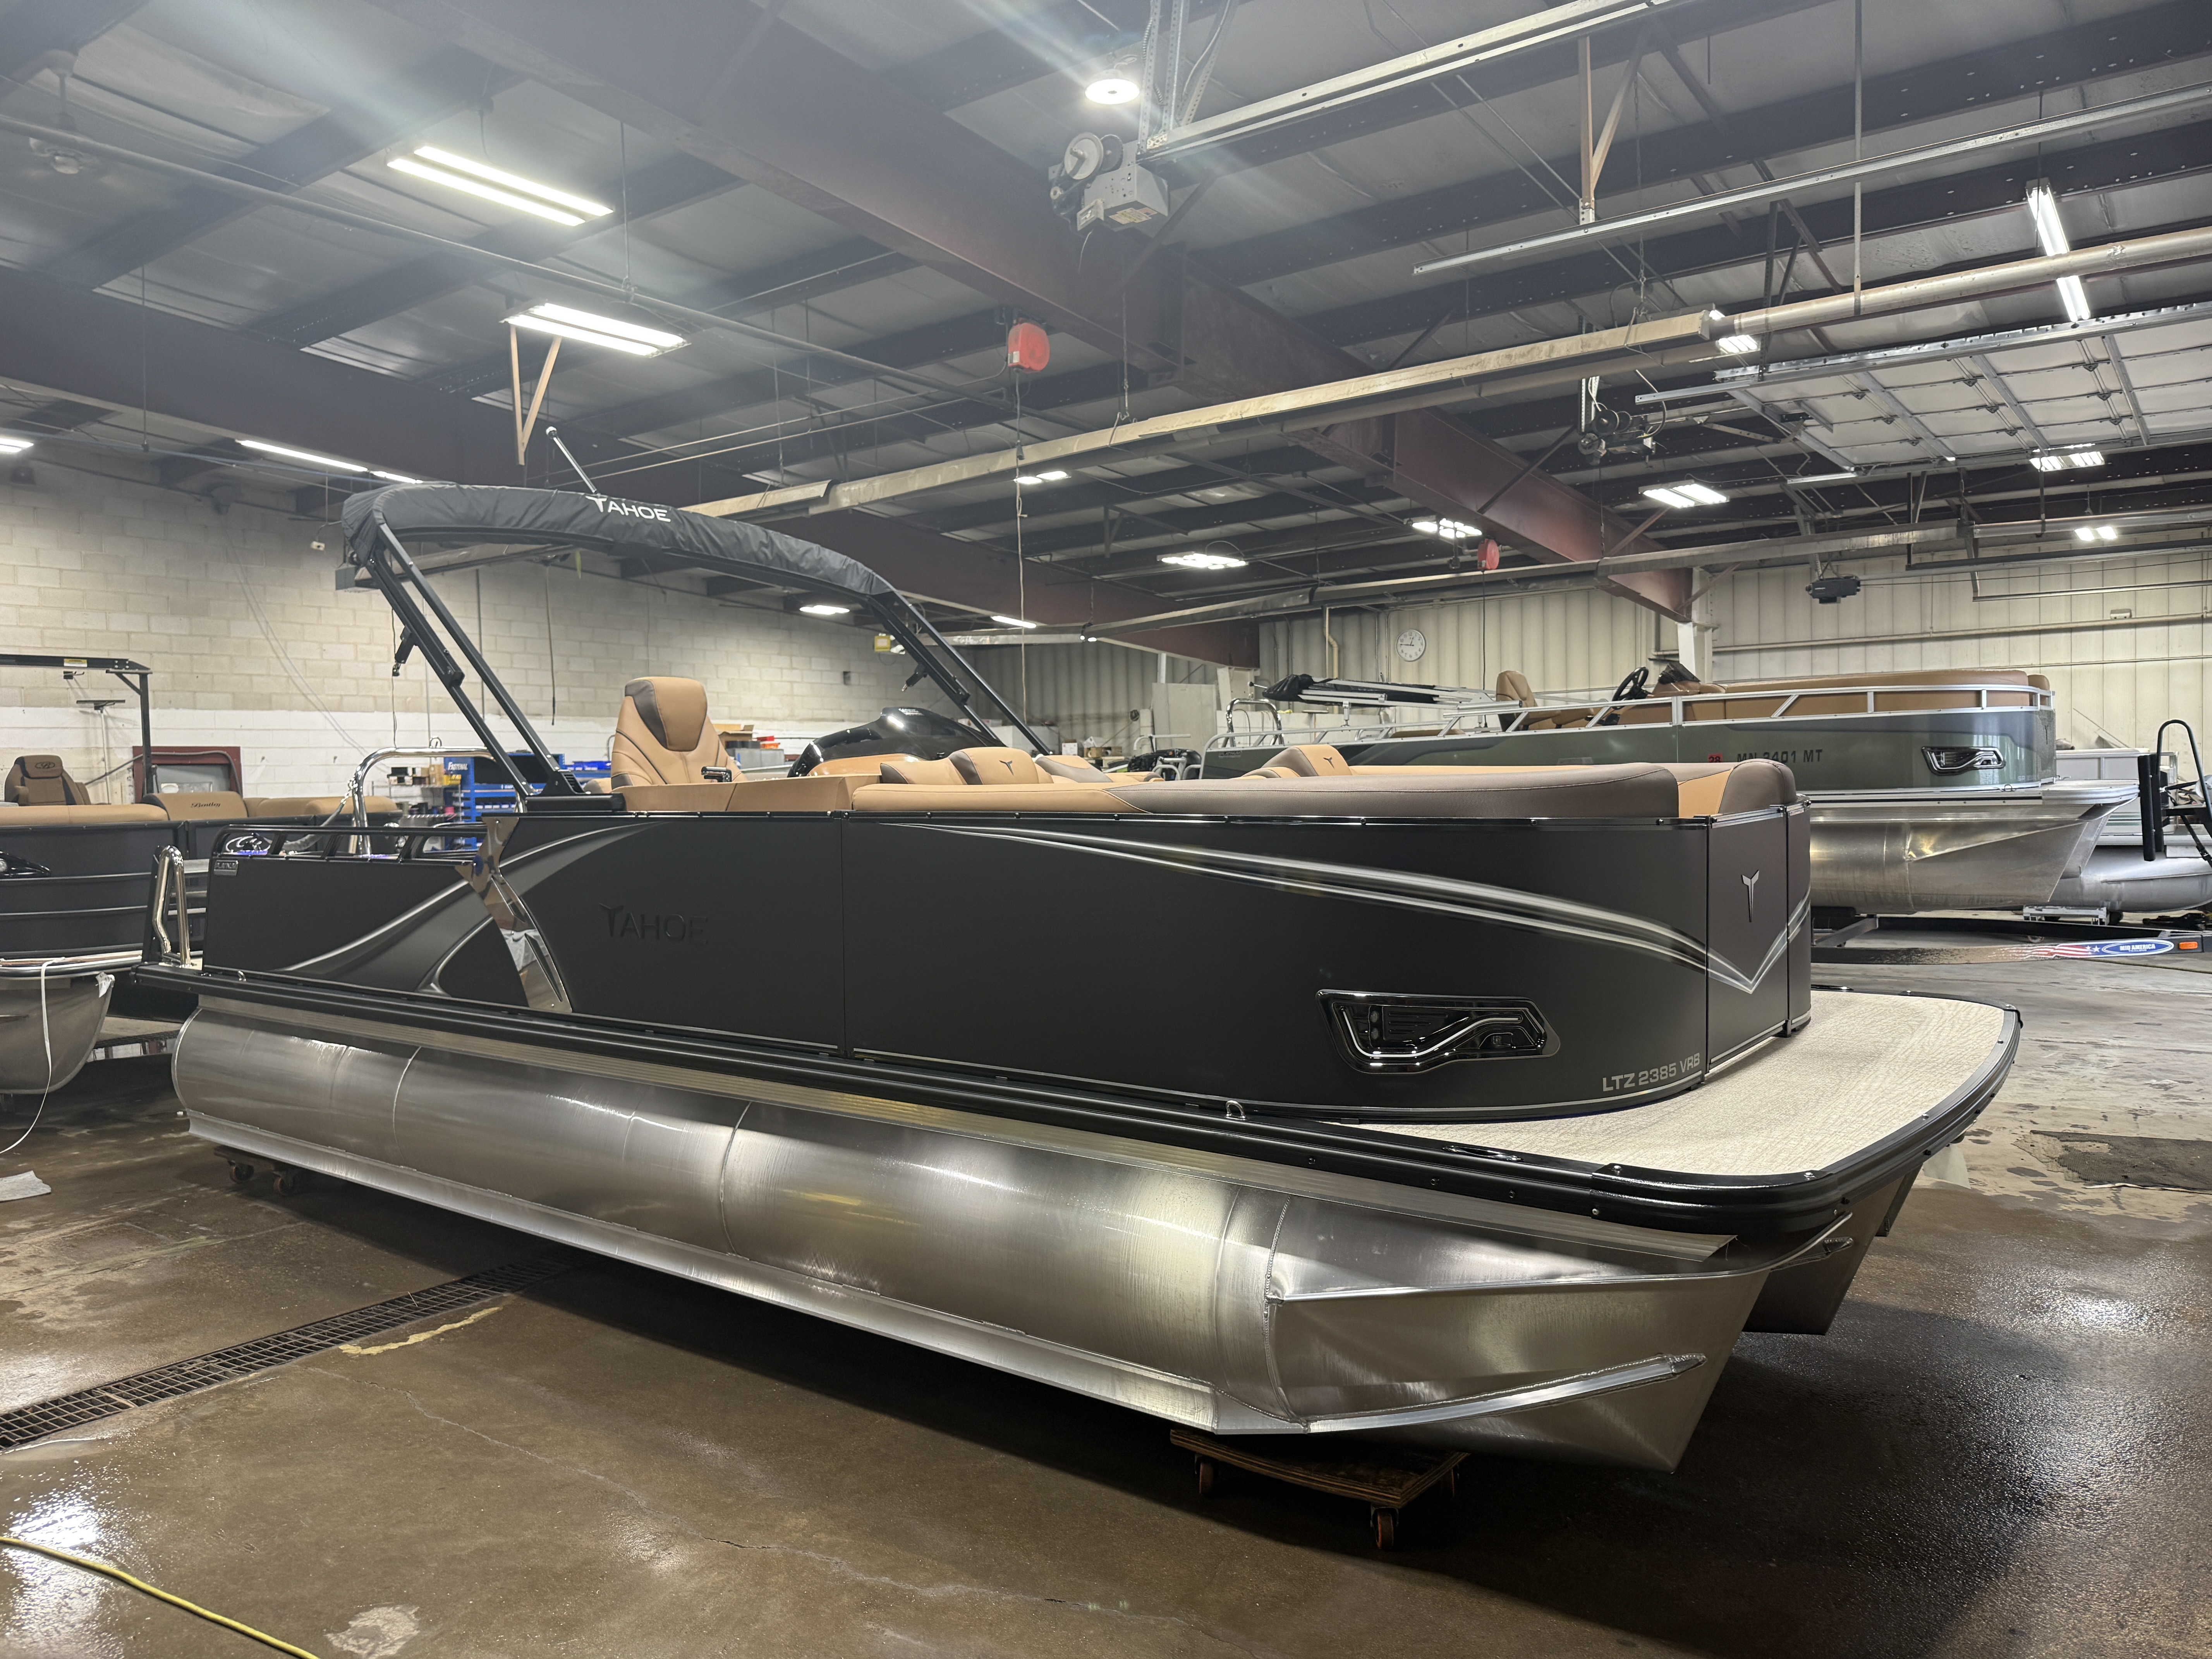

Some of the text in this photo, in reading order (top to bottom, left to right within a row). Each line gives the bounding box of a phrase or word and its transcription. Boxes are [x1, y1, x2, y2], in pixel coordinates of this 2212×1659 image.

[585, 496, 671, 522] TAHOE
[1803, 749, 1822, 762] MT
[599, 903, 708, 945] TAHOE
[1602, 1053, 1700, 1091] LTZ 2385 VRB
